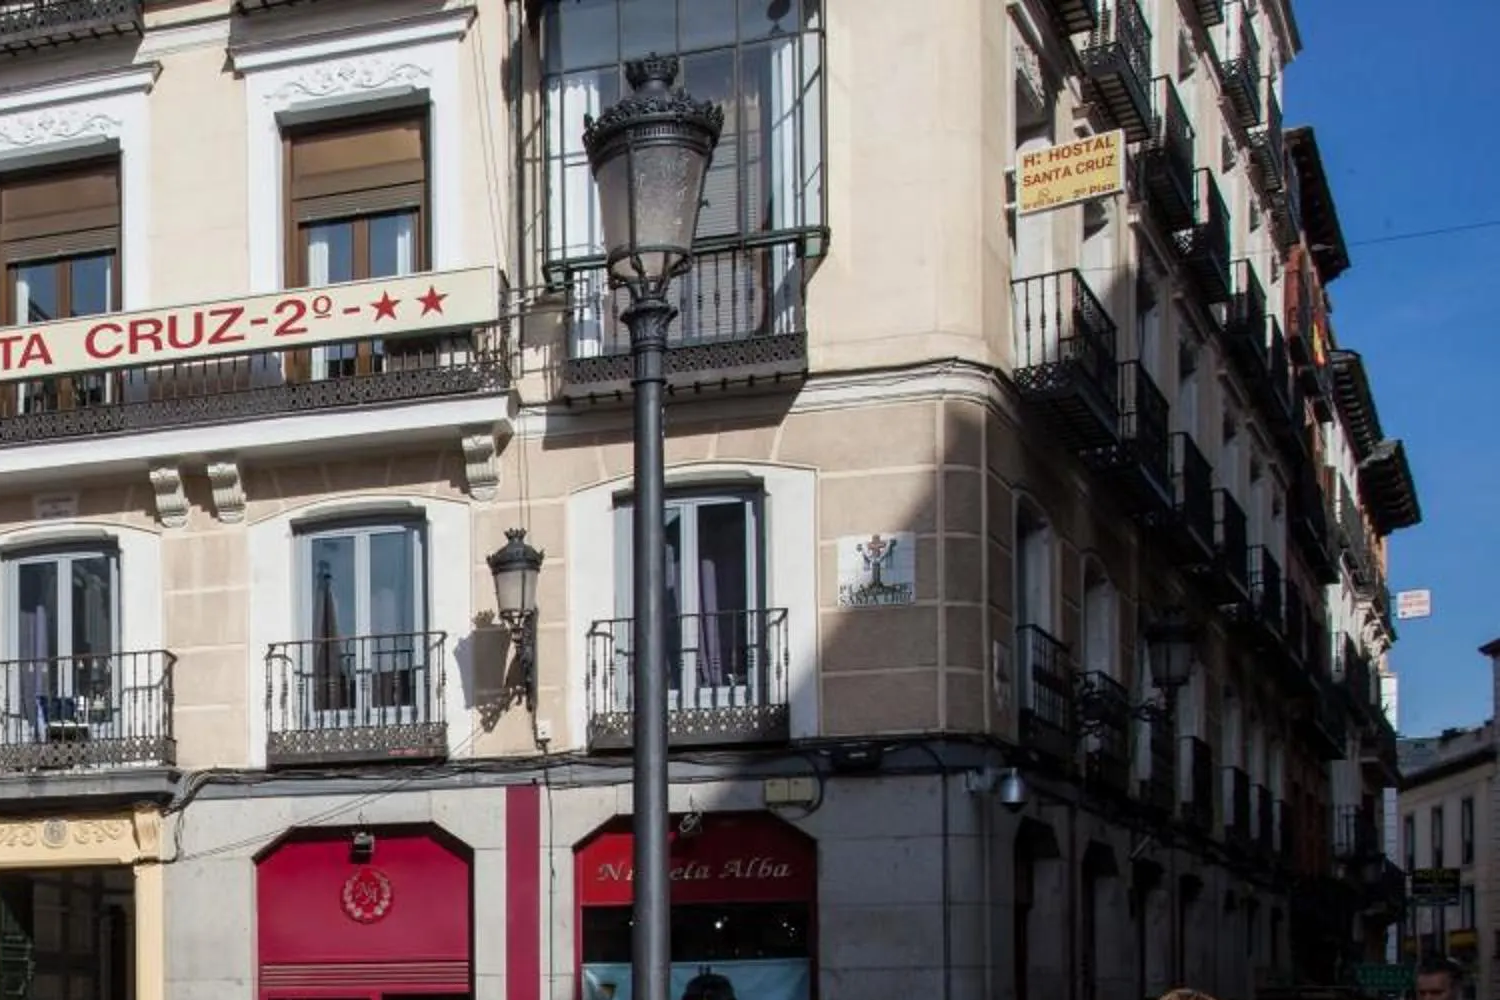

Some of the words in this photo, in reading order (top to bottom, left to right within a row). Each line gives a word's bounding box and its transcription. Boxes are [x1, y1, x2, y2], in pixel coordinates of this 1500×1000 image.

[1048, 135, 1116, 162] HOSTAL
[1023, 164, 1073, 187] SANTA
[1075, 153, 1115, 175] CRUZ
[718, 856, 791, 880] Alba
